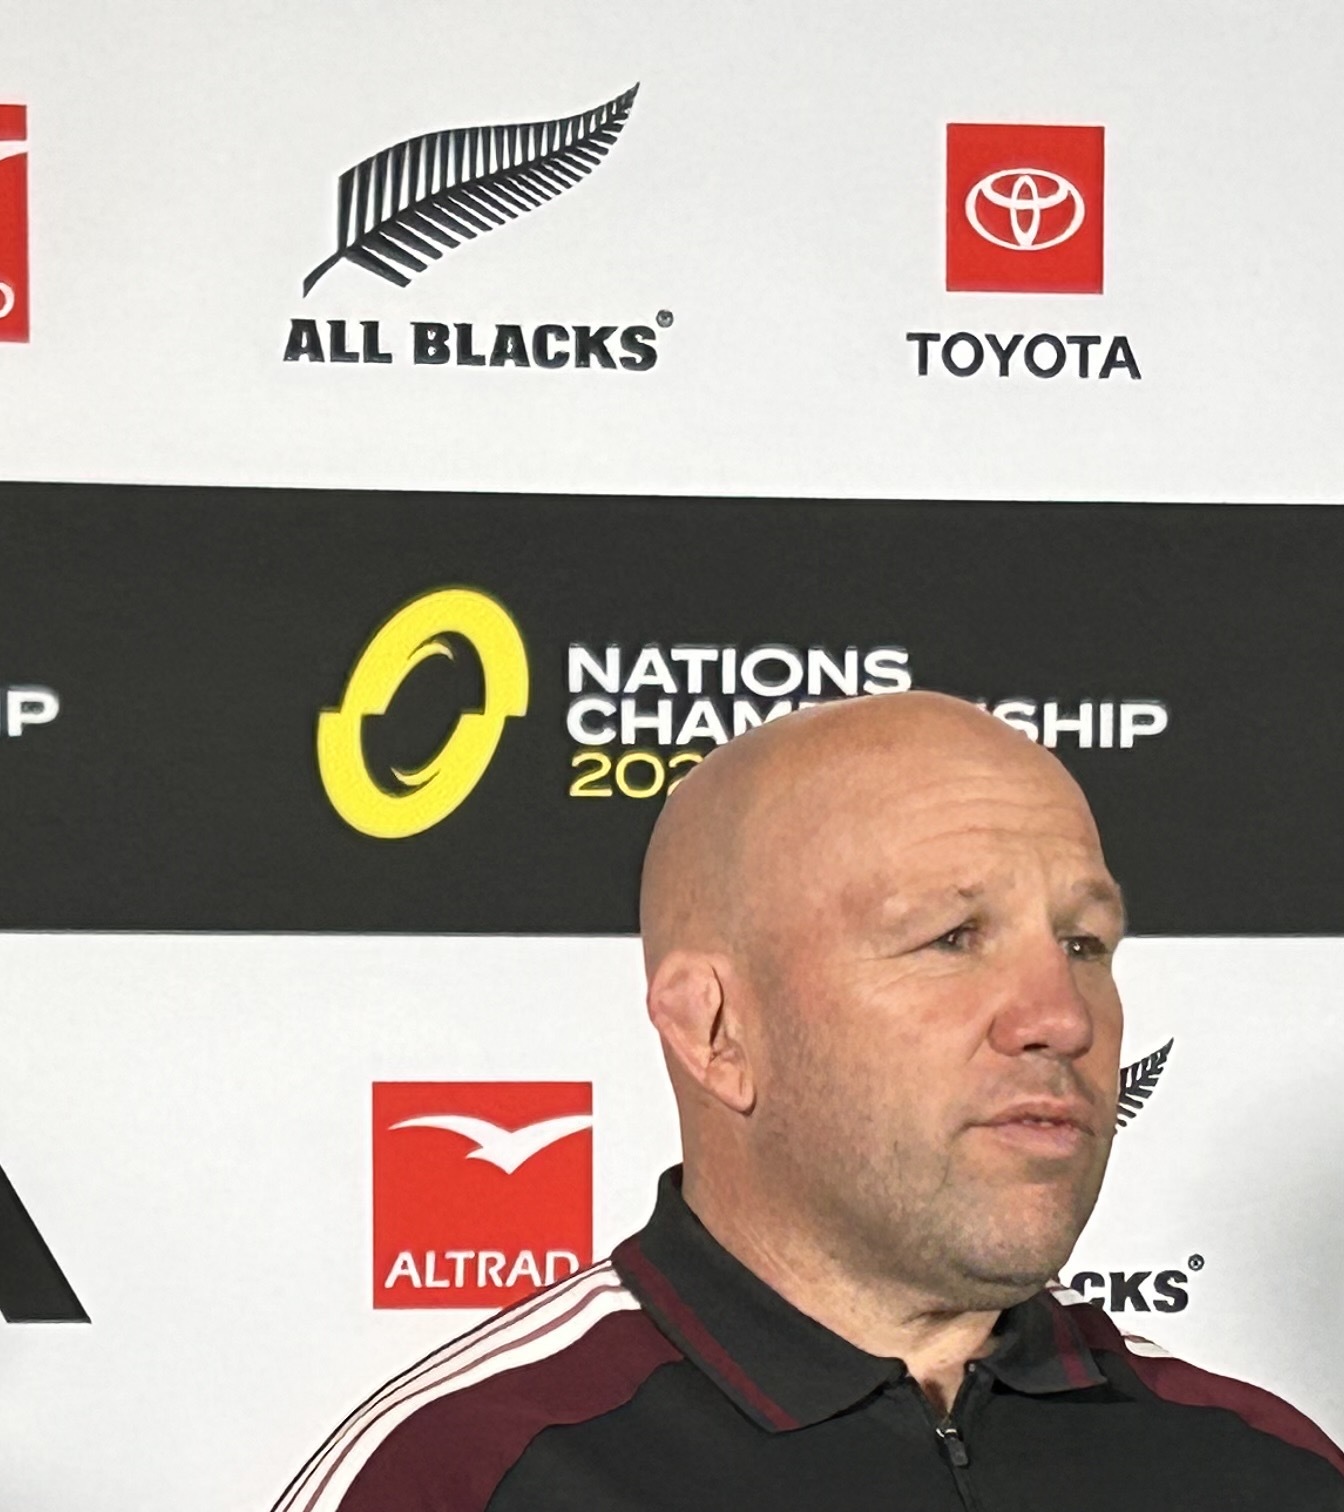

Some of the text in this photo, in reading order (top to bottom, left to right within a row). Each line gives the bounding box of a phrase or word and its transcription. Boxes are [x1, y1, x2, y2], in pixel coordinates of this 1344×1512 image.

[282, 318, 658, 372] ALL BLACKS
[905, 331, 1142, 380] TOYOTA
[567, 645, 912, 697] NATIONS
[569, 751, 703, 799] 202
[384, 1251, 579, 1289] ALTRAD
[1070, 1269, 1189, 1314] CKS
